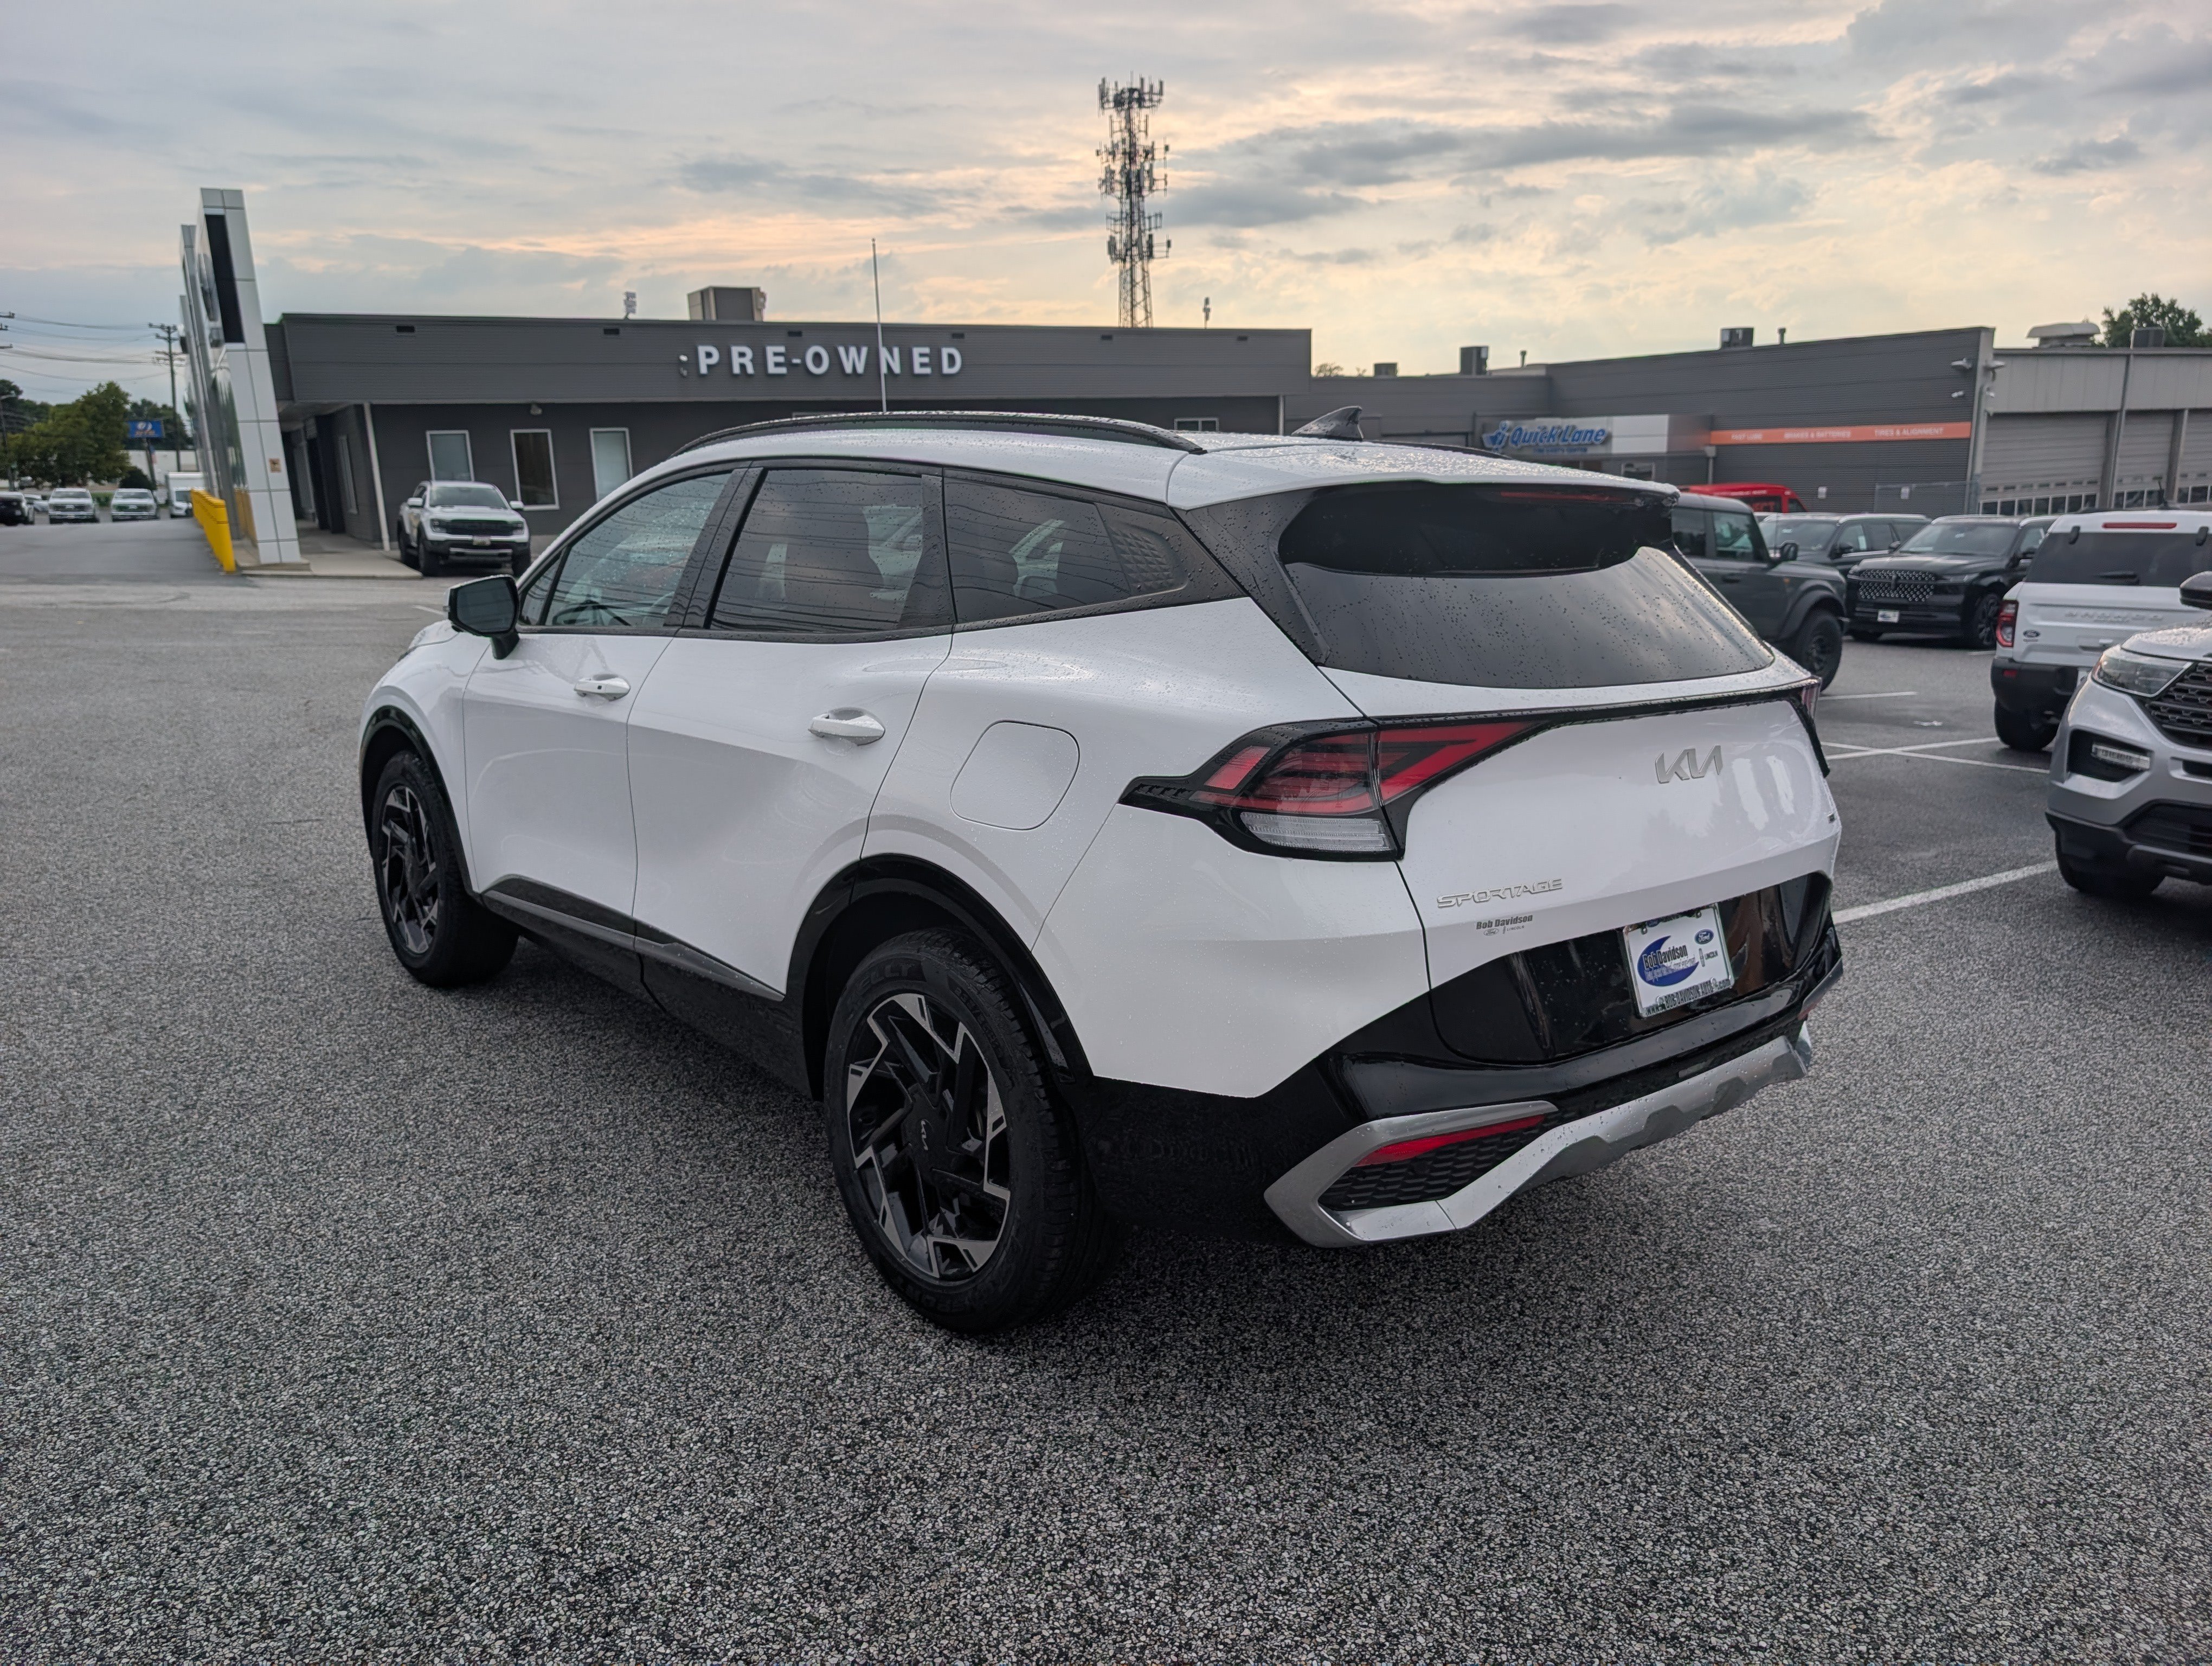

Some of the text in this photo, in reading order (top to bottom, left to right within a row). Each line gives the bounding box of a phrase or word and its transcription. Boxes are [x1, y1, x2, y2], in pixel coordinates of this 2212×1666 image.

[696, 345, 963, 375] PRE-OWNED
[1509, 424, 1608, 446] Quick Lane
[1902, 427, 1944, 436] ALIGNMENT
[1655, 745, 1724, 784] KIA
[1437, 878, 1563, 908] SPORTAGE
[1476, 914, 1533, 930] Bob Davidson
[1643, 952, 1658, 969] Bob
[1656, 944, 1688, 964] Davidson
